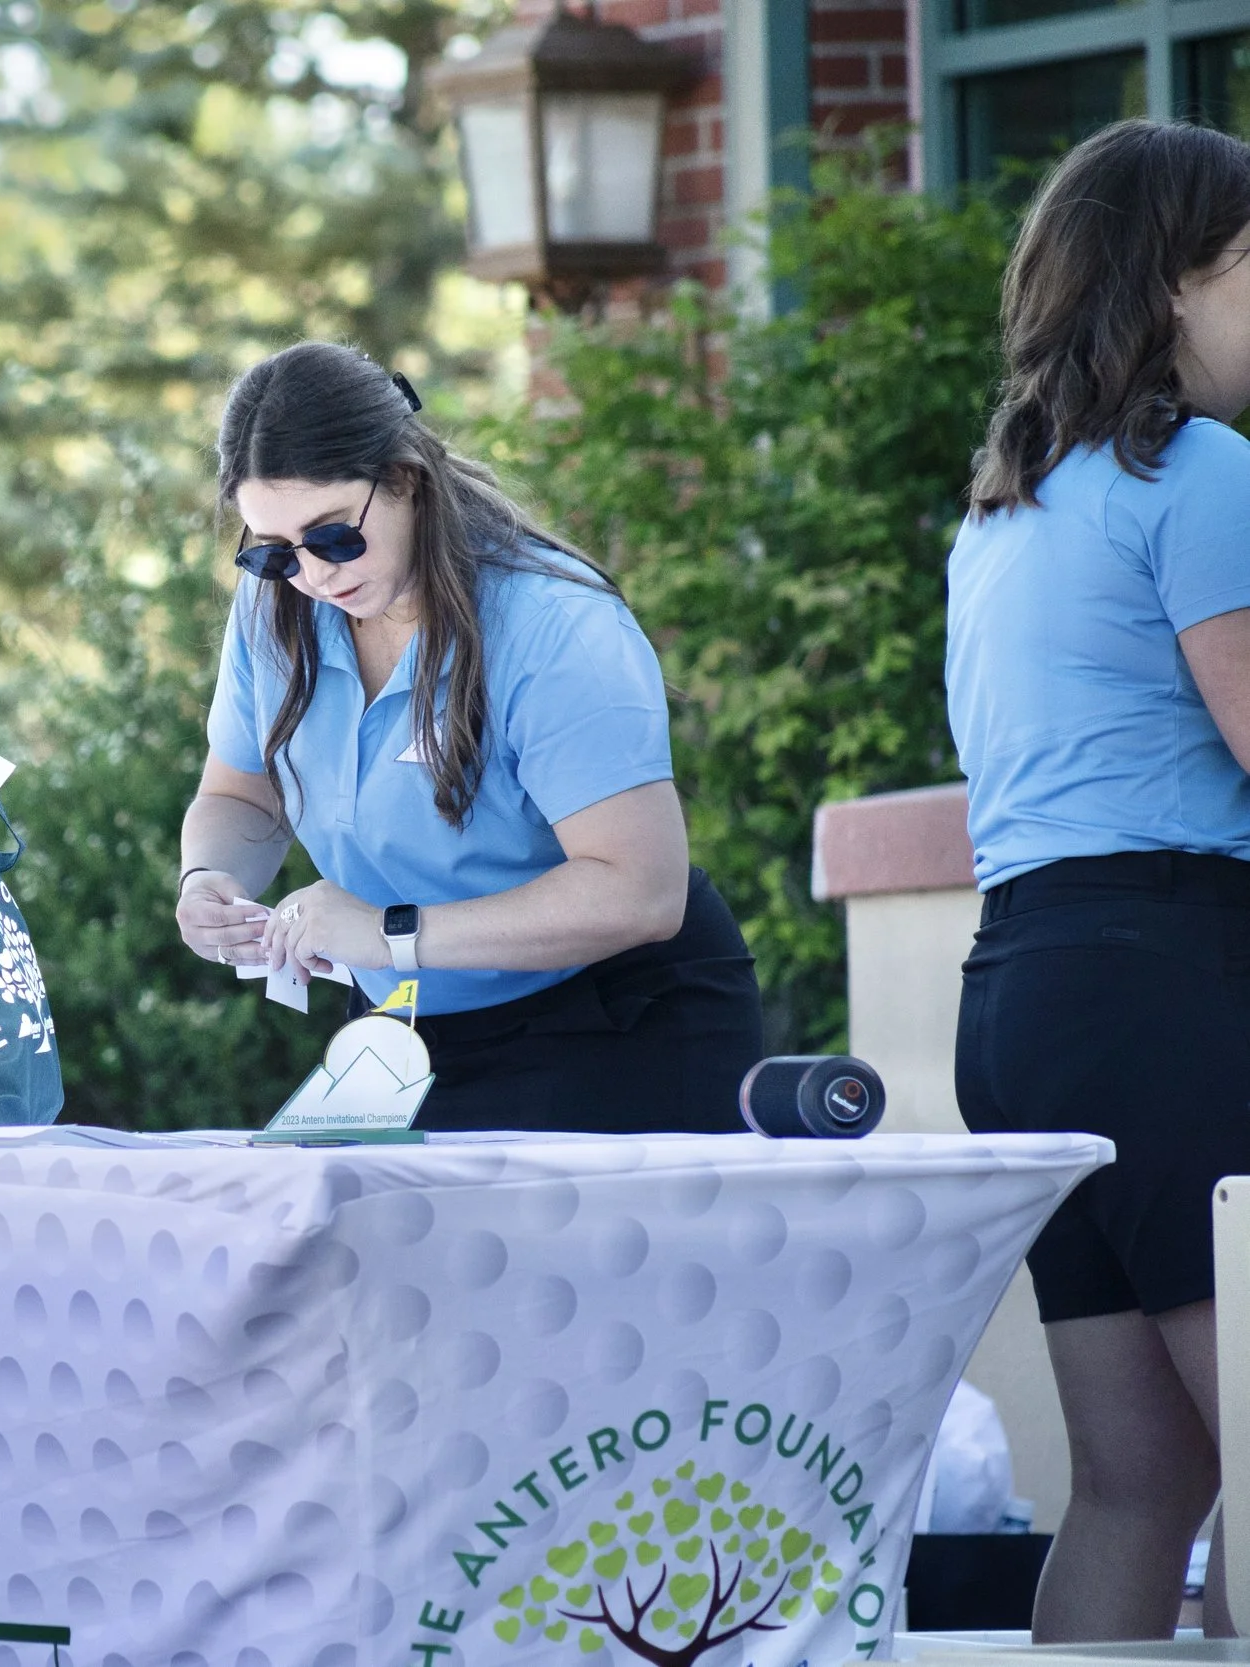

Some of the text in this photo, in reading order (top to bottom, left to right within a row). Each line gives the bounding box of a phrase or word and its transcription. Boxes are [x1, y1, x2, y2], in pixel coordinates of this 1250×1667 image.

[403, 984, 413, 1003] 1
[281, 1113, 408, 1126] 2023 Antero Invitational Champions
[451, 1409, 672, 1589] ANTERO
